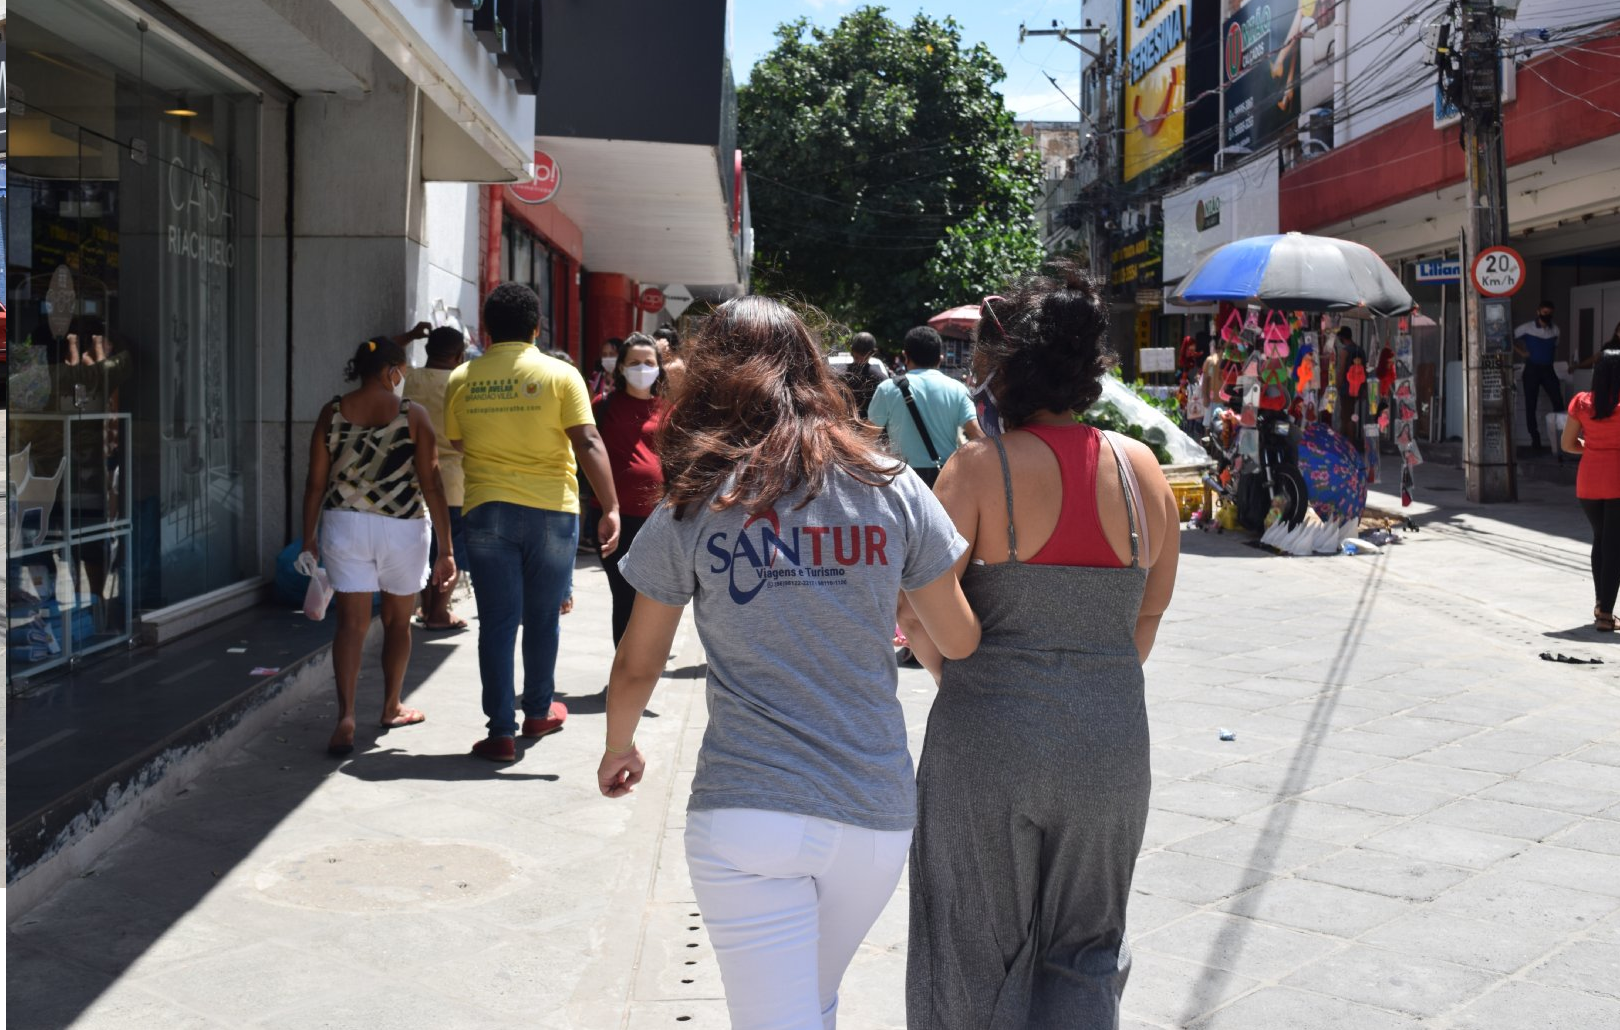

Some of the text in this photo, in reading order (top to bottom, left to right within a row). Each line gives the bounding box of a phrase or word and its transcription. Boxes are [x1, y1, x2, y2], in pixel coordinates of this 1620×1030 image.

[1128, 5, 1184, 86] TERESINA
[168, 157, 234, 226] CASA
[168, 225, 235, 268] RIACHUELO
[1486, 255, 1509, 272] 20
[1482, 275, 1514, 286] Km/h
[706, 523, 889, 576] SANTUR
[756, 567, 796, 580] Viagens
[805, 566, 845, 577] Turismo
